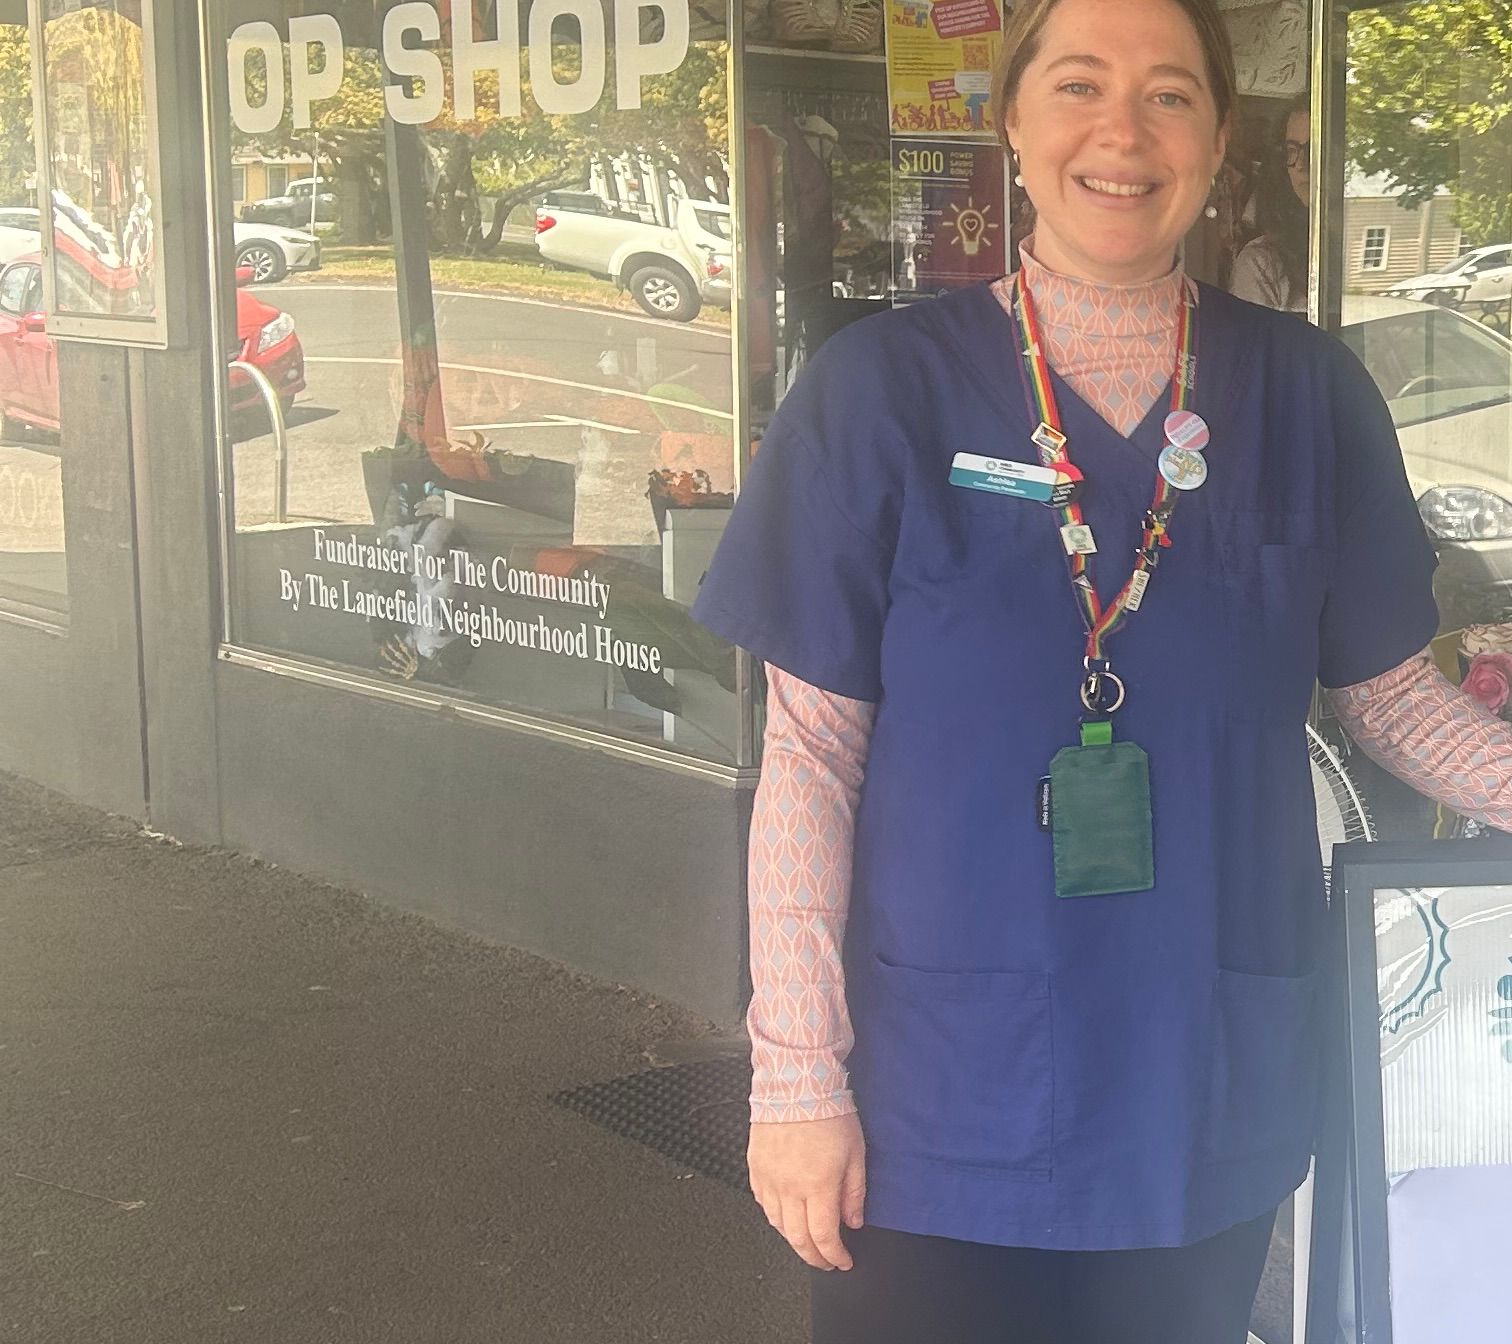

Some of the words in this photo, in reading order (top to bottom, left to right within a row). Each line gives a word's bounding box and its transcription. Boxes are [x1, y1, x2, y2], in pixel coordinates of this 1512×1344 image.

[226, 13, 344, 134] OP
[899, 148, 944, 174] $100
[279, 568, 302, 611] By
[305, 573, 339, 611] The
[341, 579, 433, 628] Lancefield
[438, 596, 589, 659] Neighbourhood
[593, 624, 661, 674] House
[313, 528, 408, 575] Fundraiser
[412, 543, 446, 581] For
[449, 548, 487, 588] The
[491, 555, 611, 619] Community
